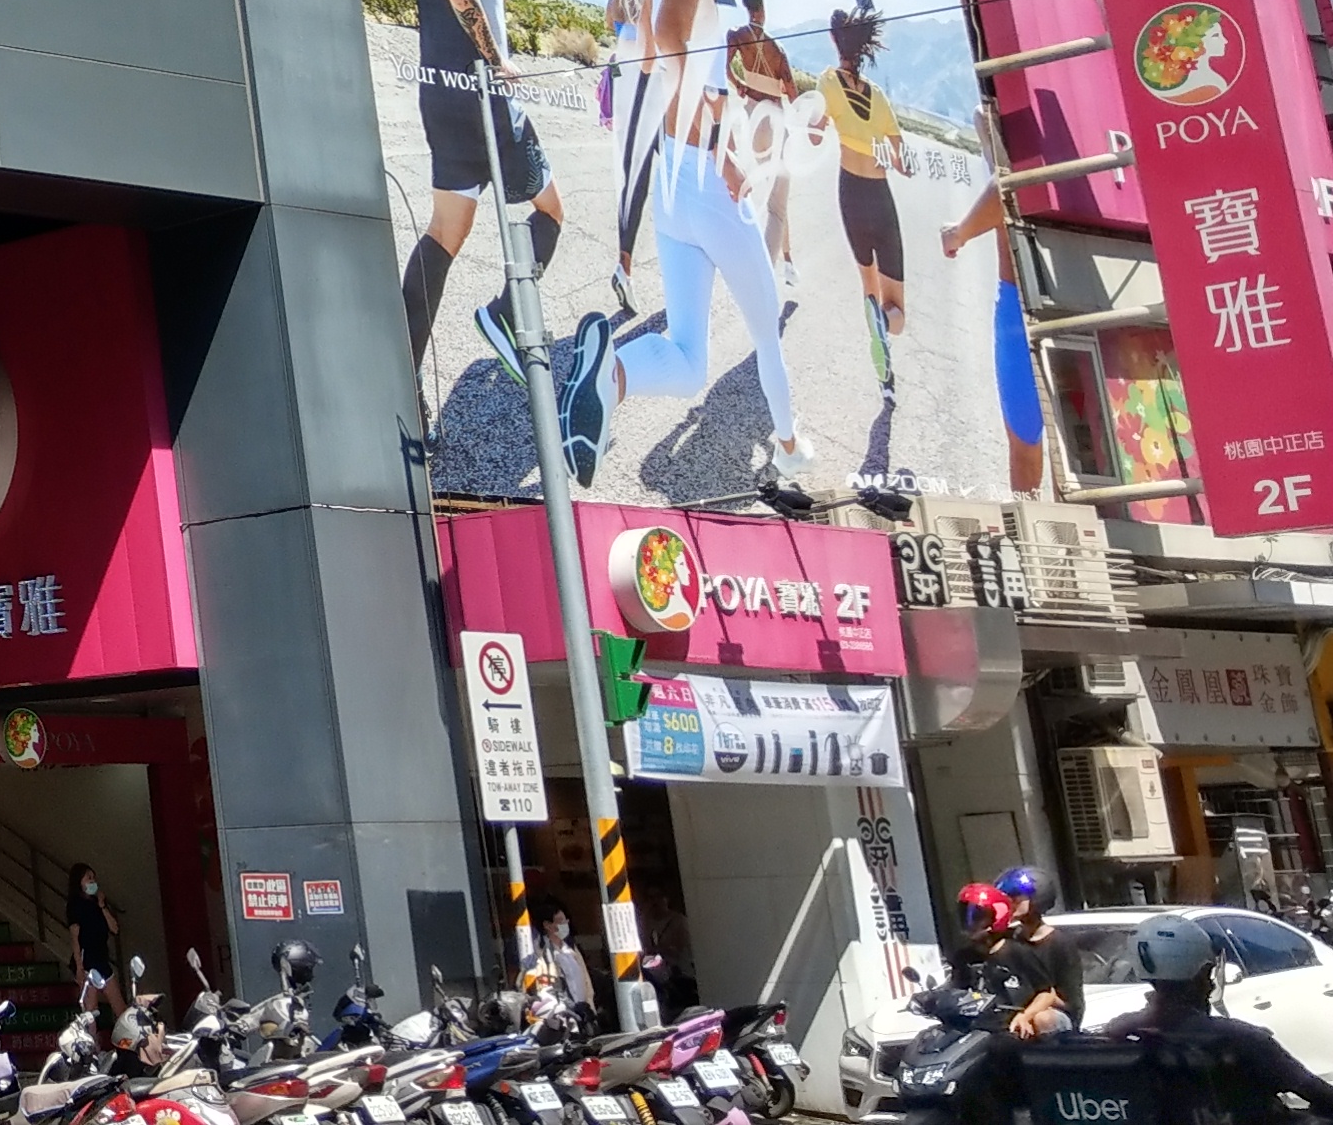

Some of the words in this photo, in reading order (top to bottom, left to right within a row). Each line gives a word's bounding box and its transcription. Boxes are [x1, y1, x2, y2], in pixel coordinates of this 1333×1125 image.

[390, 54, 436, 86] Your
[545, 83, 587, 110] with
[1156, 105, 1259, 150] POYA
[1184, 187, 1291, 354] 寶雅
[1223, 431, 1325, 460] 桃園中正店
[1253, 475, 1312, 515] 2F
[699, 573, 776, 613] POYA
[834, 584, 871, 620] 2F
[663, 712, 699, 733] $600
[492, 740, 534, 753] SIDEWALK
[664, 736, 676, 755] 8
[485, 759, 537, 777] 違者拖吊
[512, 799, 533, 813] 110
[1056, 1091, 1131, 1124] Uber
